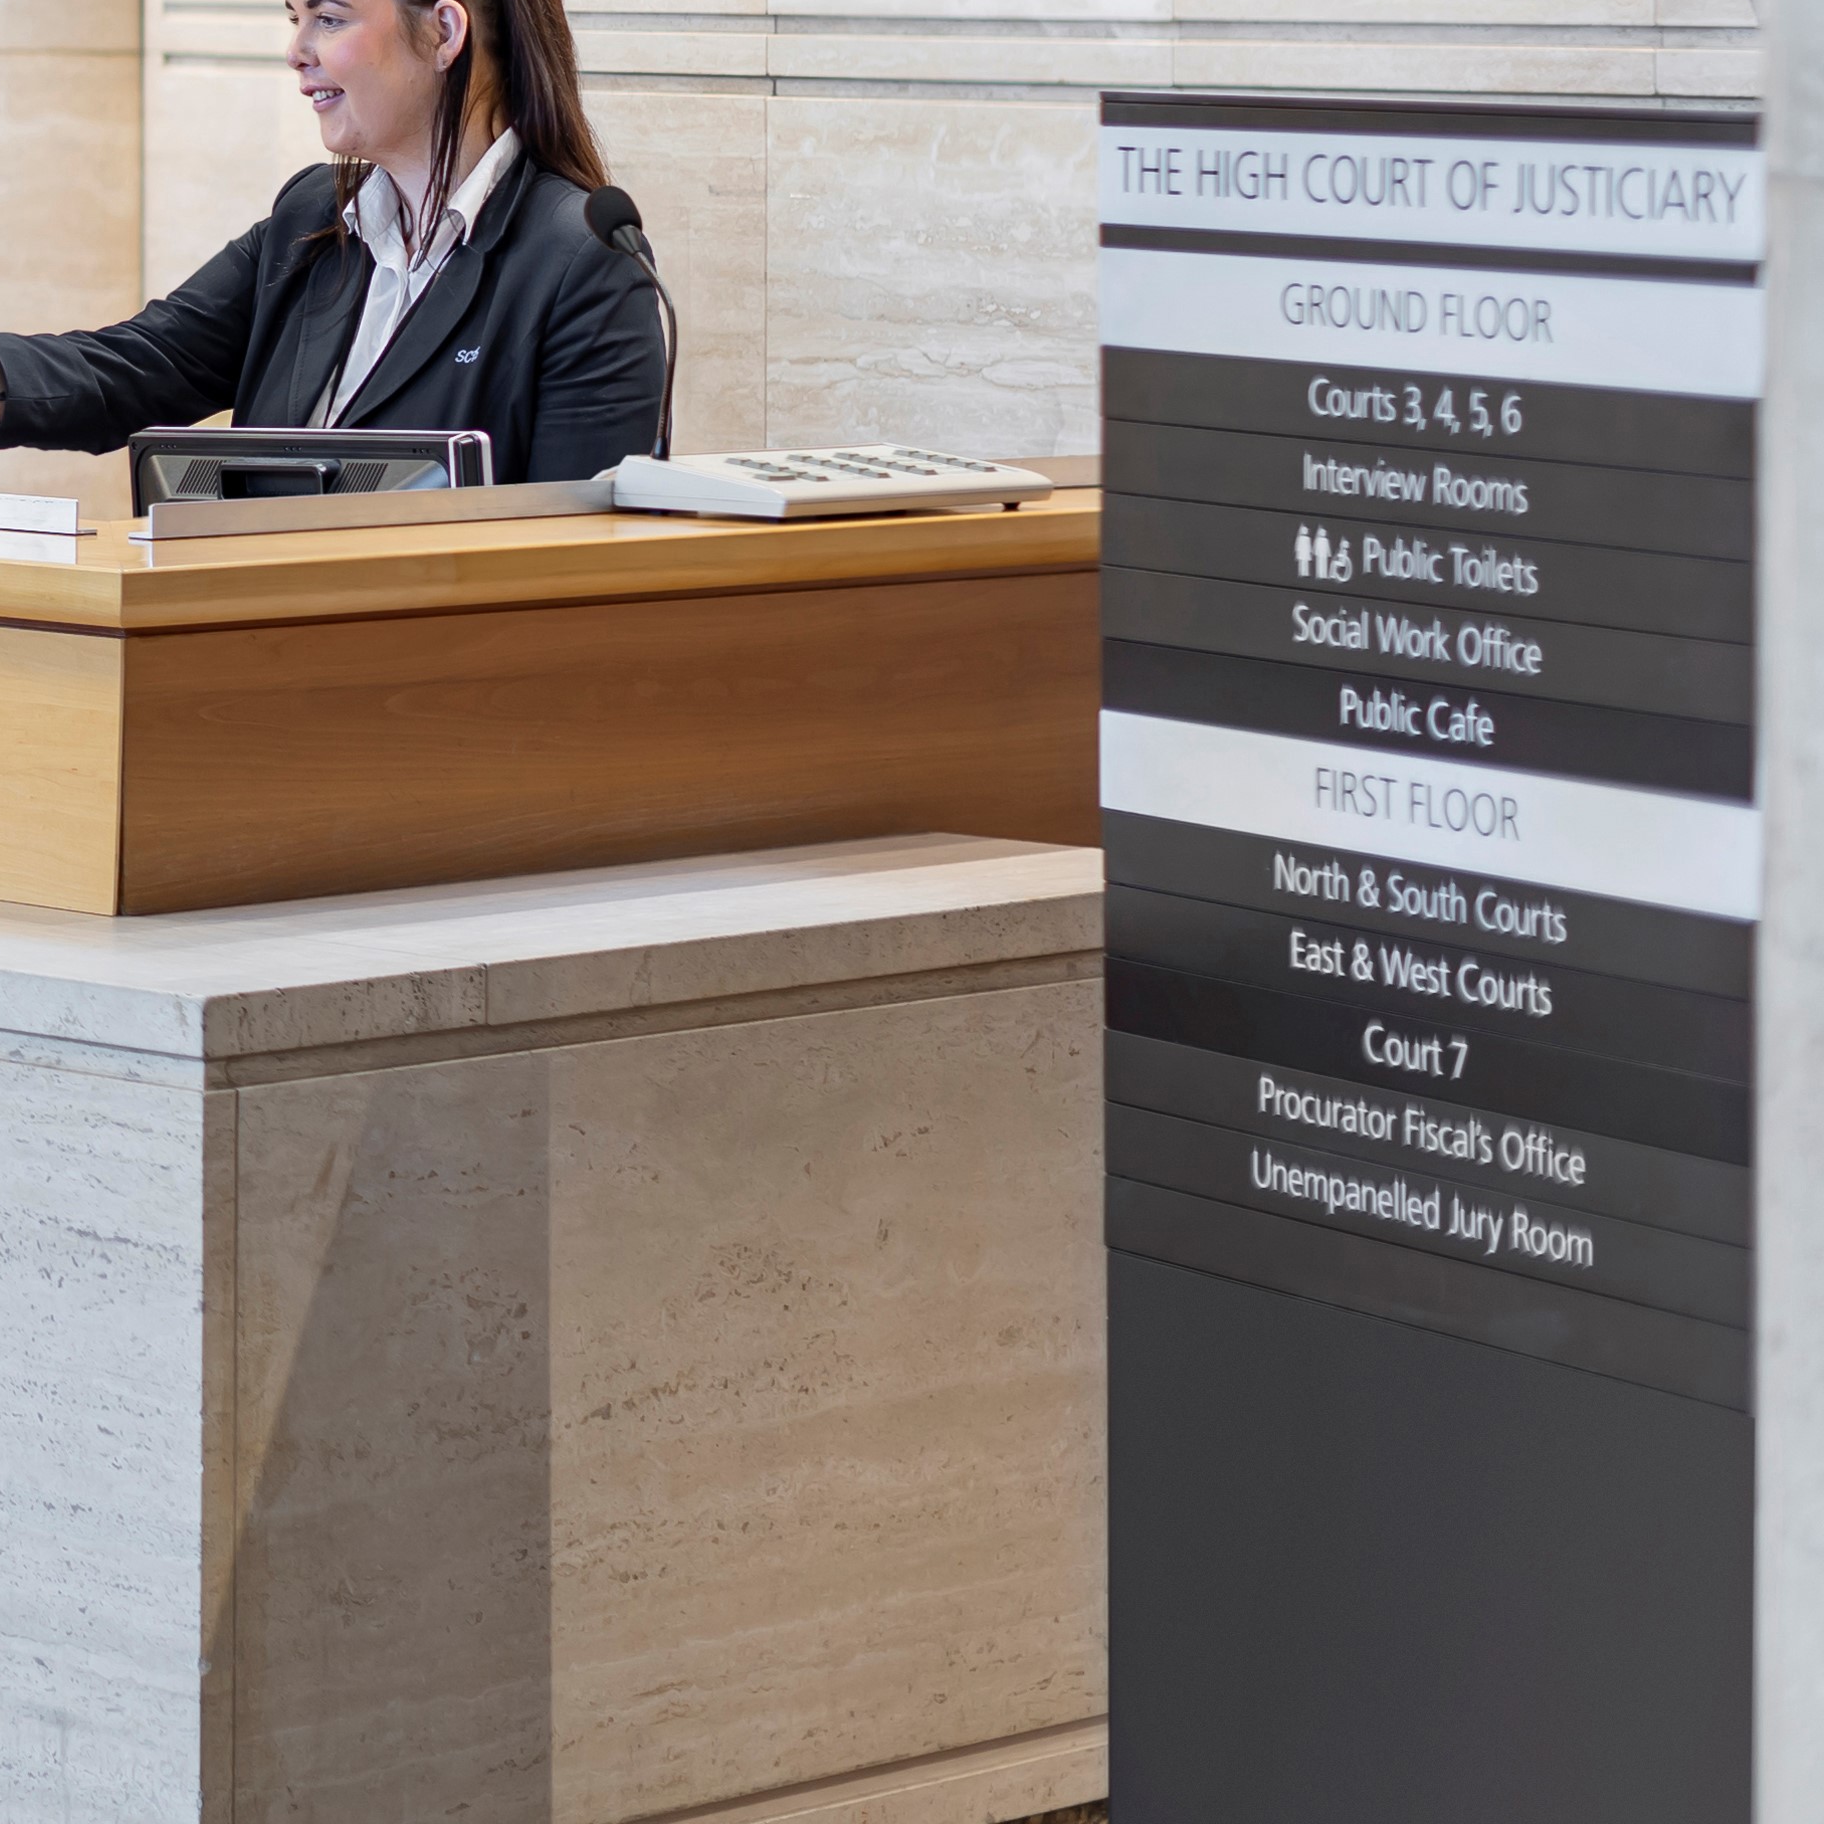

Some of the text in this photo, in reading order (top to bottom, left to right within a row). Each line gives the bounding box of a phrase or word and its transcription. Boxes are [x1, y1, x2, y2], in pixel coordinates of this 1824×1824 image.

[1117, 145, 1747, 225] THE HIGH COURT OF JUSTICIARY
[1280, 281, 1554, 345] GROUND FLOOR
[1307, 377, 1523, 438] Courts 3, 4, 5, 6
[1303, 452, 1529, 516] Interview Rooms
[1362, 534, 1539, 596] Public Toilets
[1292, 603, 1543, 676] Social Work Office
[1339, 685, 1495, 748] Public Cafe
[1315, 766, 1521, 843] FIRST FLOOR
[1273, 851, 1567, 945] North & South Courts
[1289, 928, 1552, 1017] East & West Courts
[1363, 1020, 1469, 1080] Court 7
[1259, 1072, 1396, 1142] Procurator
[1500, 1127, 1586, 1187] Office
[1251, 1148, 1595, 1269] Unempanelled Jury Room
